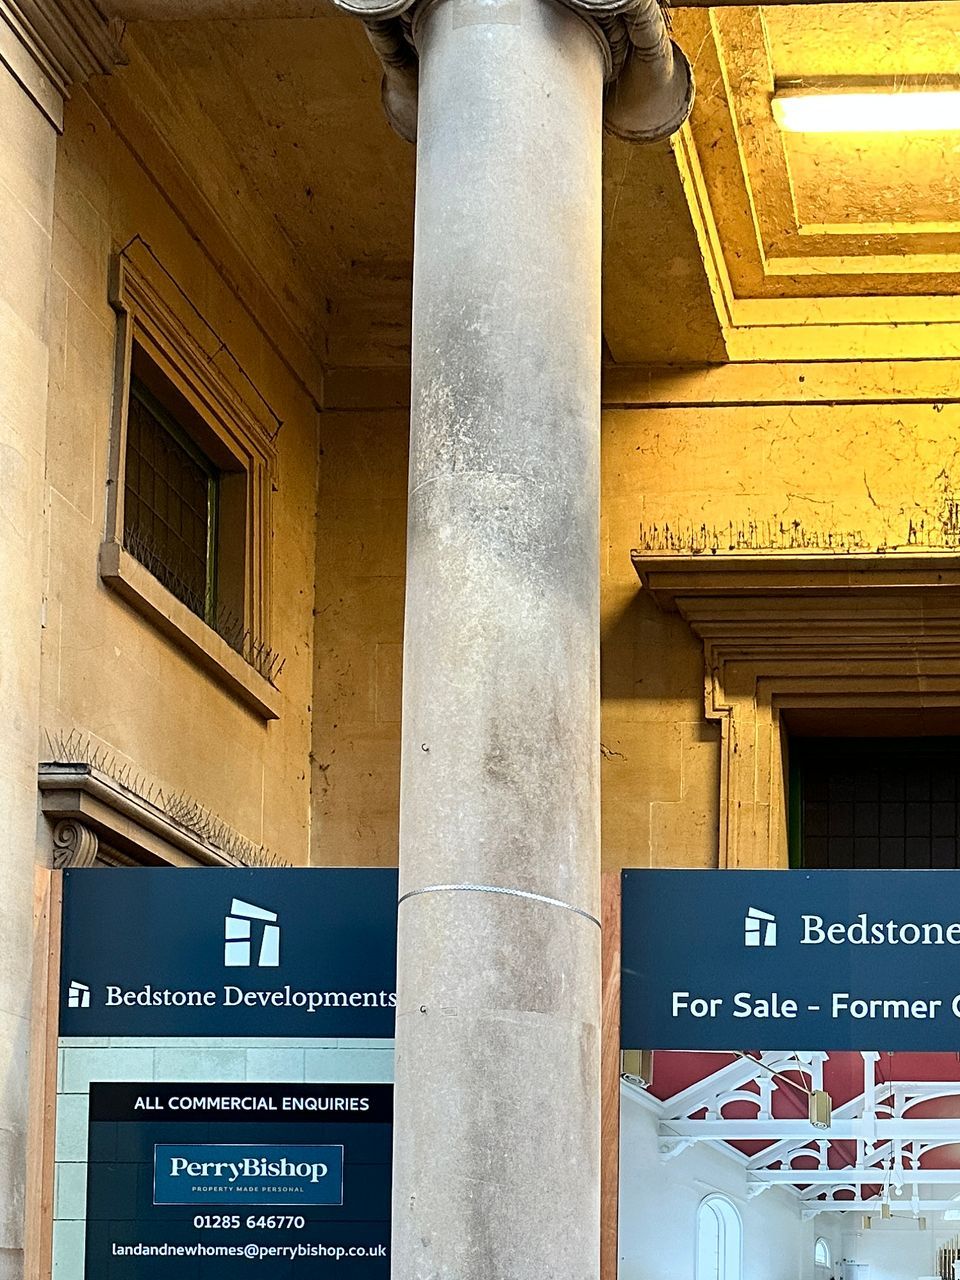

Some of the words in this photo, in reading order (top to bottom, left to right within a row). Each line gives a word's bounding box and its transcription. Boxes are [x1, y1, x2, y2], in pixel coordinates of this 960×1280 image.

[104, 984, 217, 1006] Bedstone
[222, 984, 397, 1013] Developments
[672, 991, 723, 1018] For
[732, 992, 798, 1018] Sale
[832, 993, 942, 1019] Former
[133, 1096, 164, 1110] ALL
[167, 1096, 278, 1111] COMMERCIAL
[282, 1097, 370, 1111] ENQUIRIES
[169, 1157, 328, 1183] PerryBishop
[193, 1215, 241, 1229] 01285
[246, 1215, 305, 1229] 646770
[112, 1242, 387, 1261] landandnewhomes@perrybishop.co.uk
